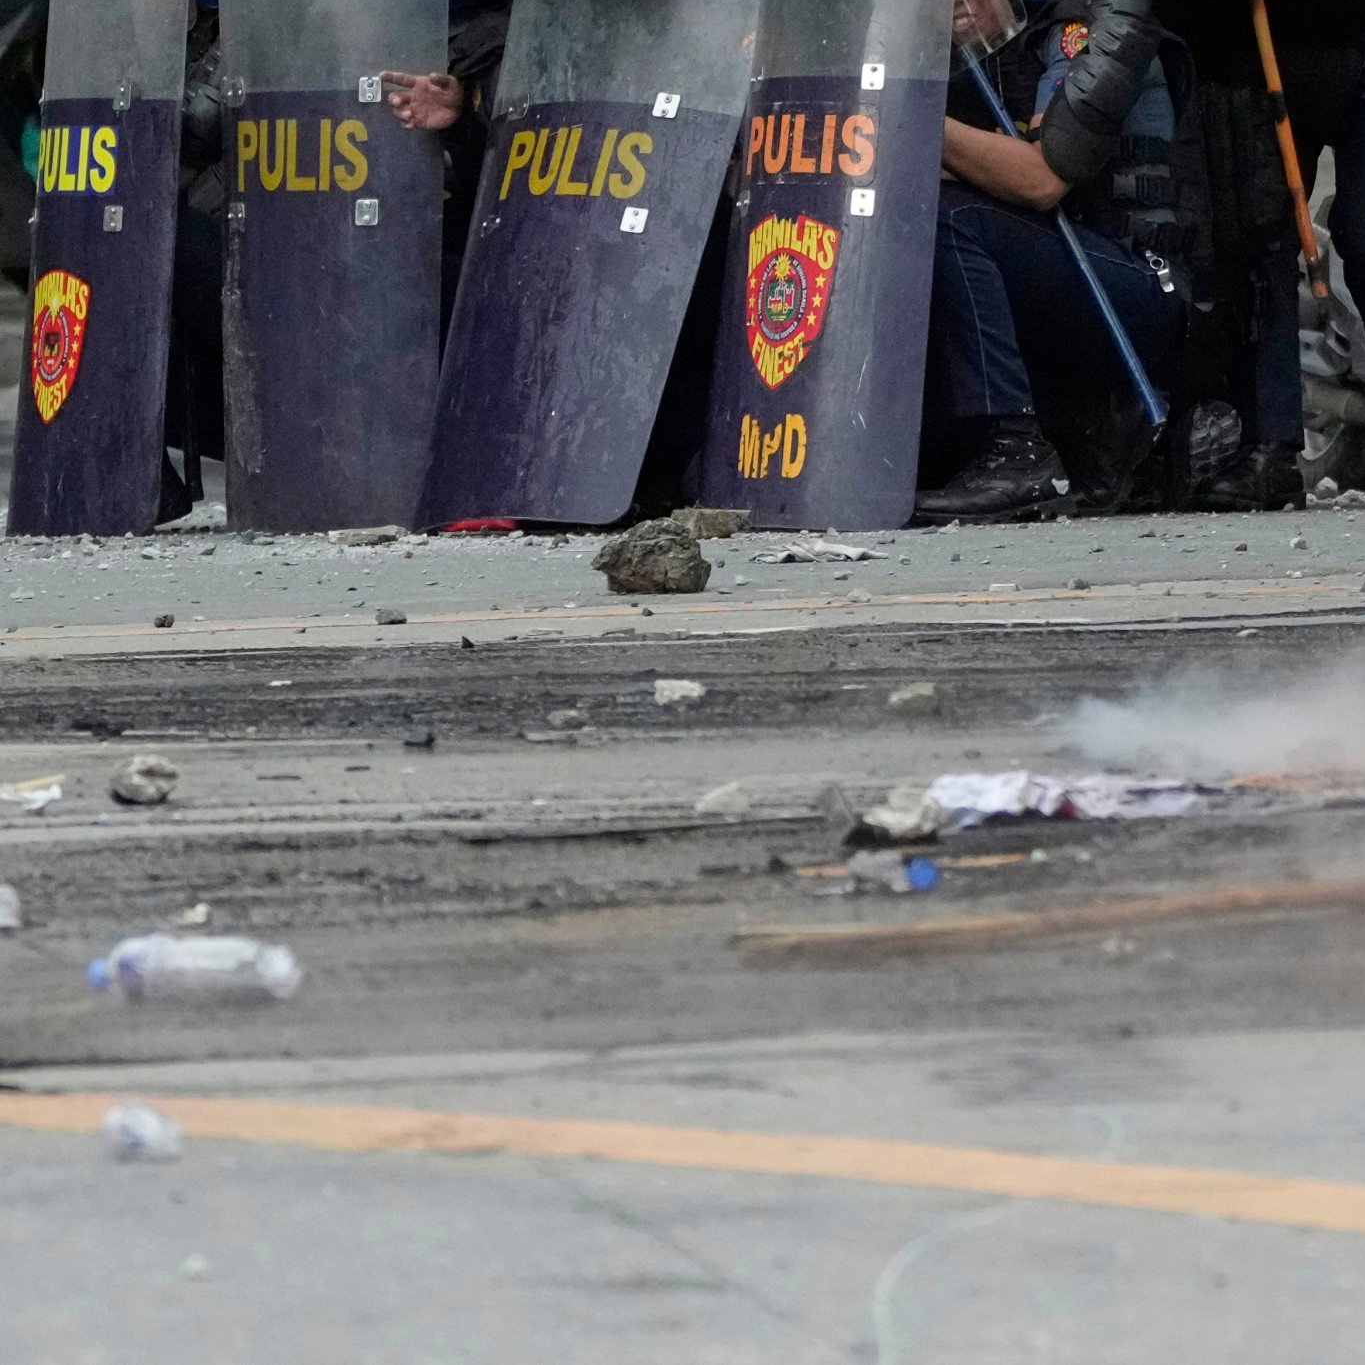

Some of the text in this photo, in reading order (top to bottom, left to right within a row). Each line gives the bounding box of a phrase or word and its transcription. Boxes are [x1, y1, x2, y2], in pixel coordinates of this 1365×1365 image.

[36, 125, 118, 193] PULIS
[237, 118, 369, 192] PULIS
[499, 126, 653, 200] PULIS
[746, 114, 876, 176] PULIS
[747, 214, 836, 277] MANILA'S
[752, 332, 804, 386] FINEST
[35, 373, 68, 421] FINEST
[738, 413, 807, 479] MPD
